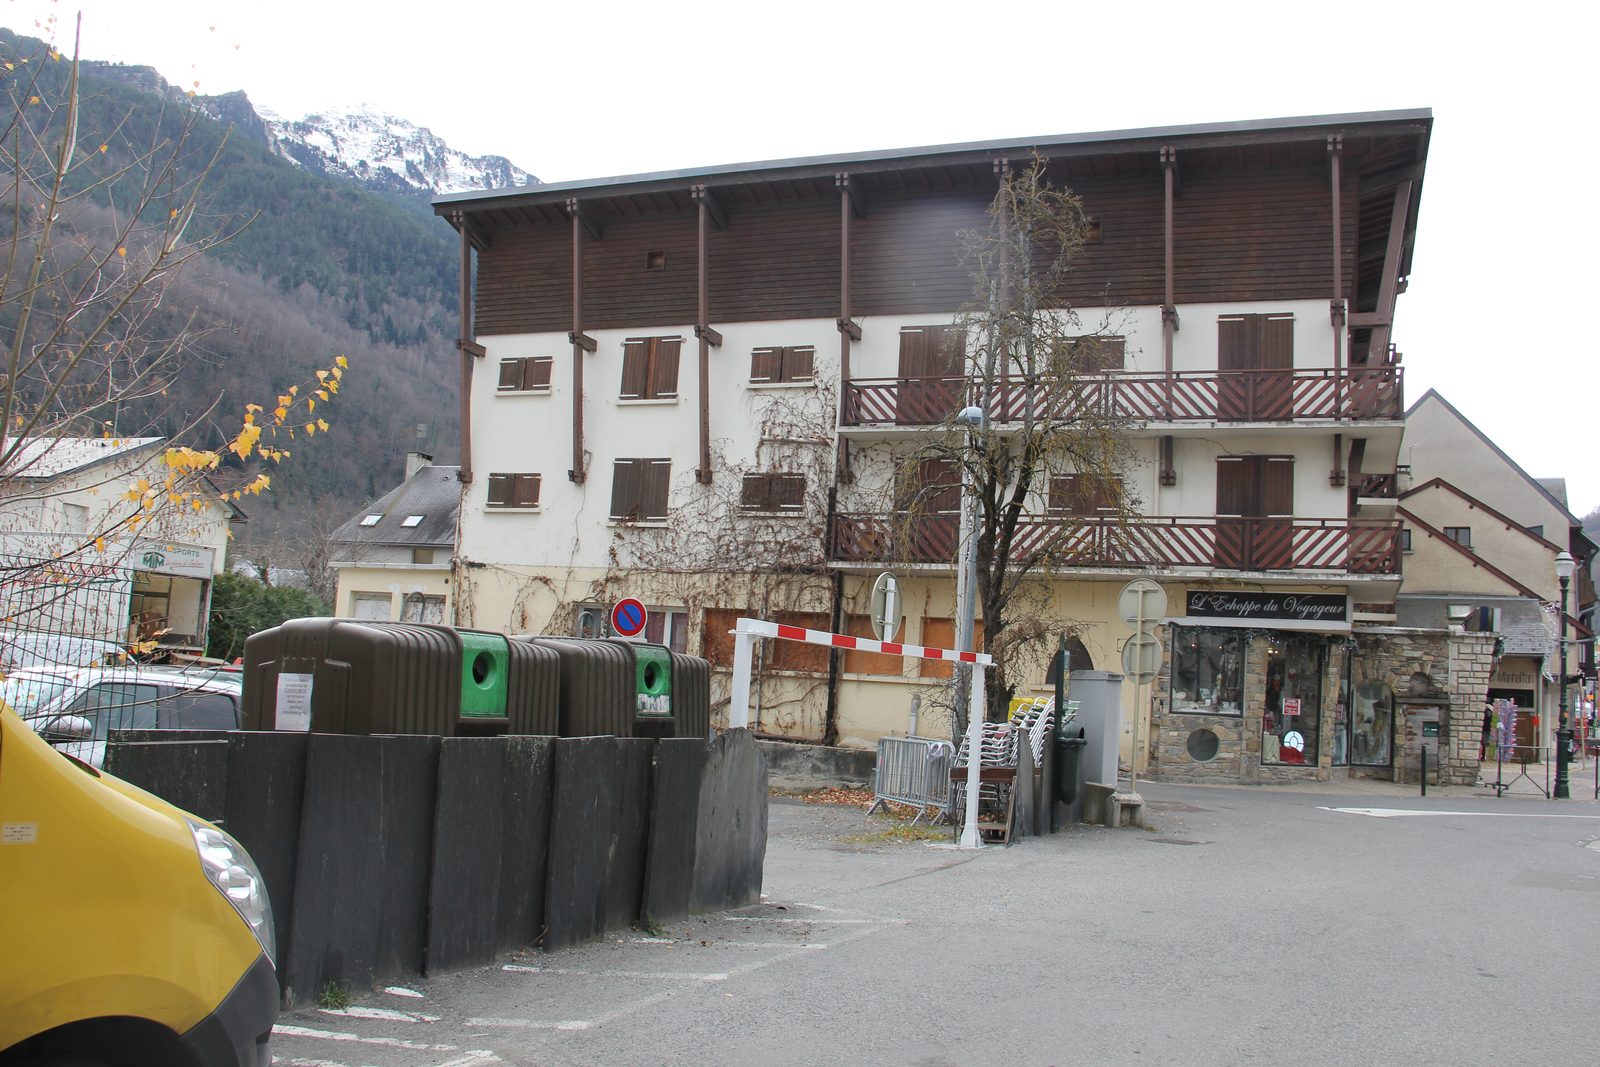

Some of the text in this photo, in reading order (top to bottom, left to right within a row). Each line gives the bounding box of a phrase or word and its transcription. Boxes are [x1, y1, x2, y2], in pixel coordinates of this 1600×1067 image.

[154, 544, 200, 558] TRASPORTS
[1263, 599, 1279, 612] du
[1283, 595, 1344, 619] Voyageur
